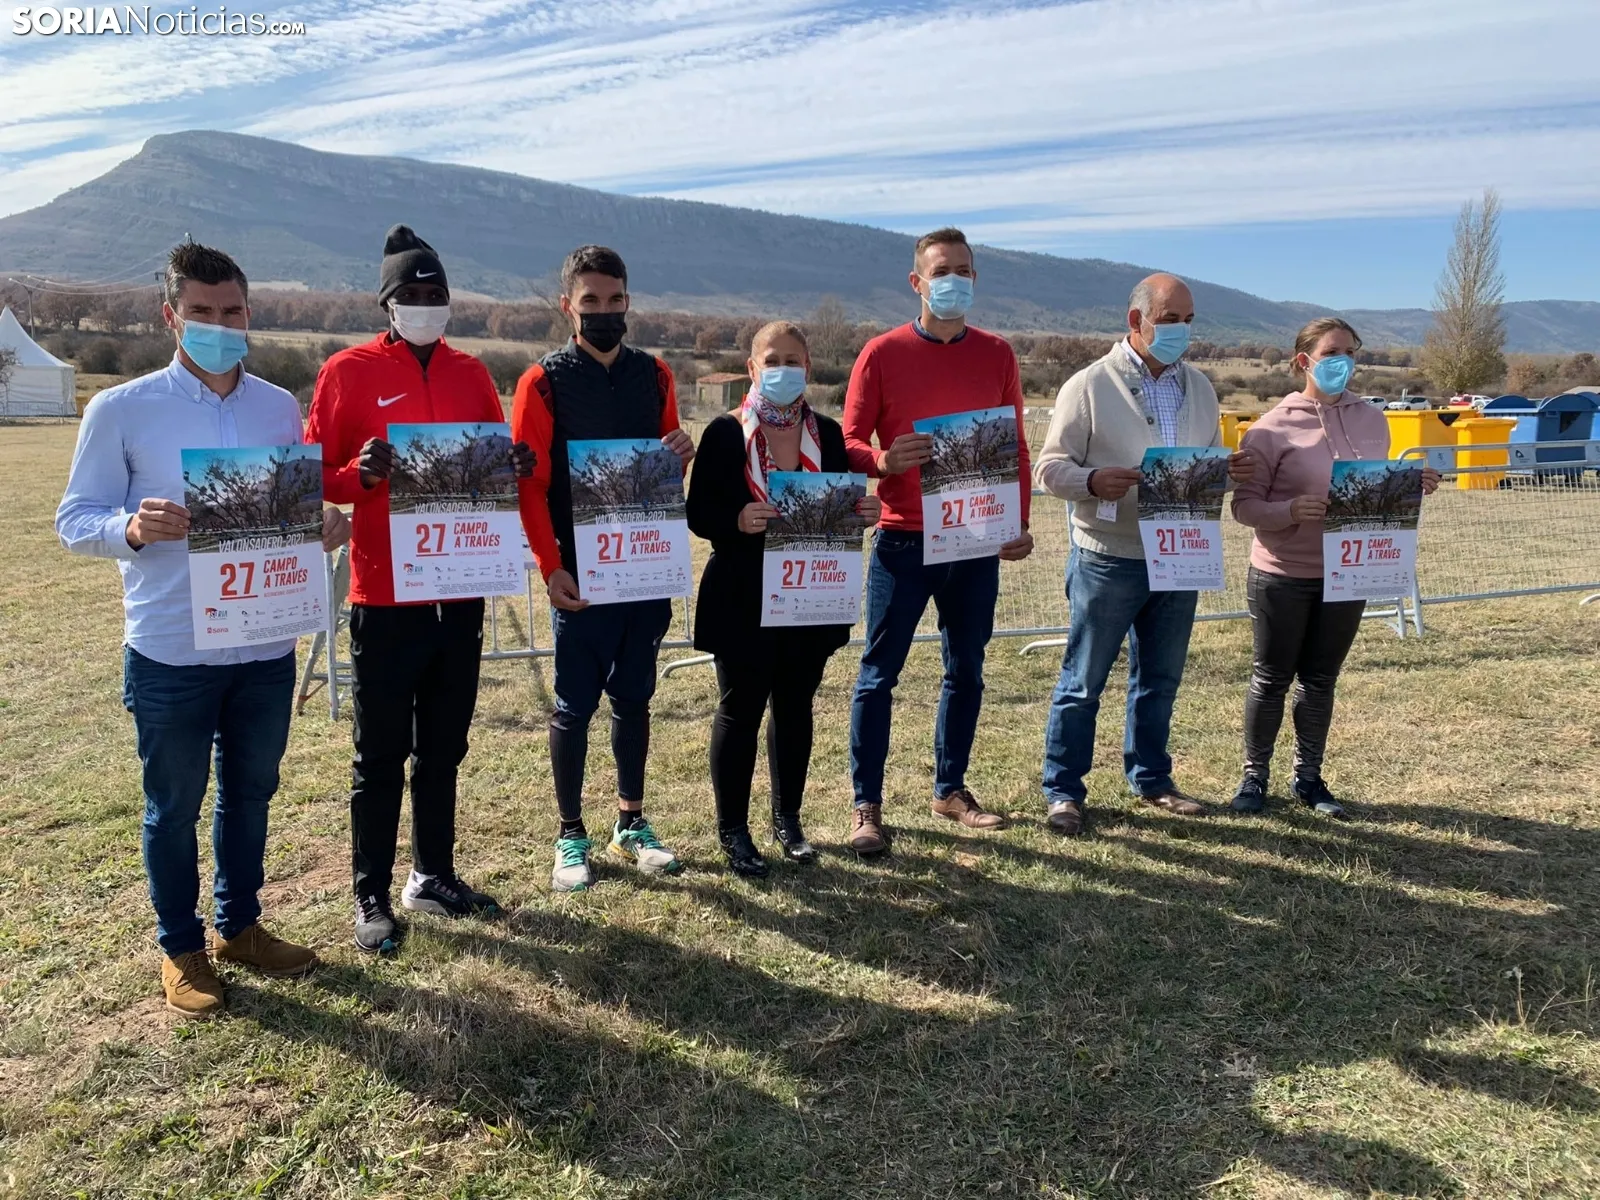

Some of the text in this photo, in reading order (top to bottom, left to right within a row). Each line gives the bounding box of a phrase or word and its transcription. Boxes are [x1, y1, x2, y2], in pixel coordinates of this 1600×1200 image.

[970, 494, 995, 507] CAMPO
[942, 499, 964, 526] 27
[970, 503, 1004, 519] A TRAVÉS
[454, 522, 488, 535] CAMPO
[1180, 528, 1201, 538] CAMPO
[416, 524, 446, 553] 27
[454, 533, 500, 548] A TRAVÉS
[630, 530, 660, 543] CAMPO
[1156, 528, 1175, 552] 27
[1182, 538, 1210, 549] A TRAVÉS
[1367, 538, 1393, 549] CAMPO
[597, 532, 623, 560] 27
[631, 540, 671, 555] A TRAVÉS
[1341, 540, 1363, 564] 27
[1367, 548, 1401, 560] A TRAVÉS
[264, 556, 298, 574] CAMPO
[782, 560, 806, 585] 27
[811, 560, 838, 571] CAMPO
[220, 562, 254, 596] 27
[264, 568, 308, 588] A TRAVÉS
[811, 570, 846, 582] A TRAVÉS
